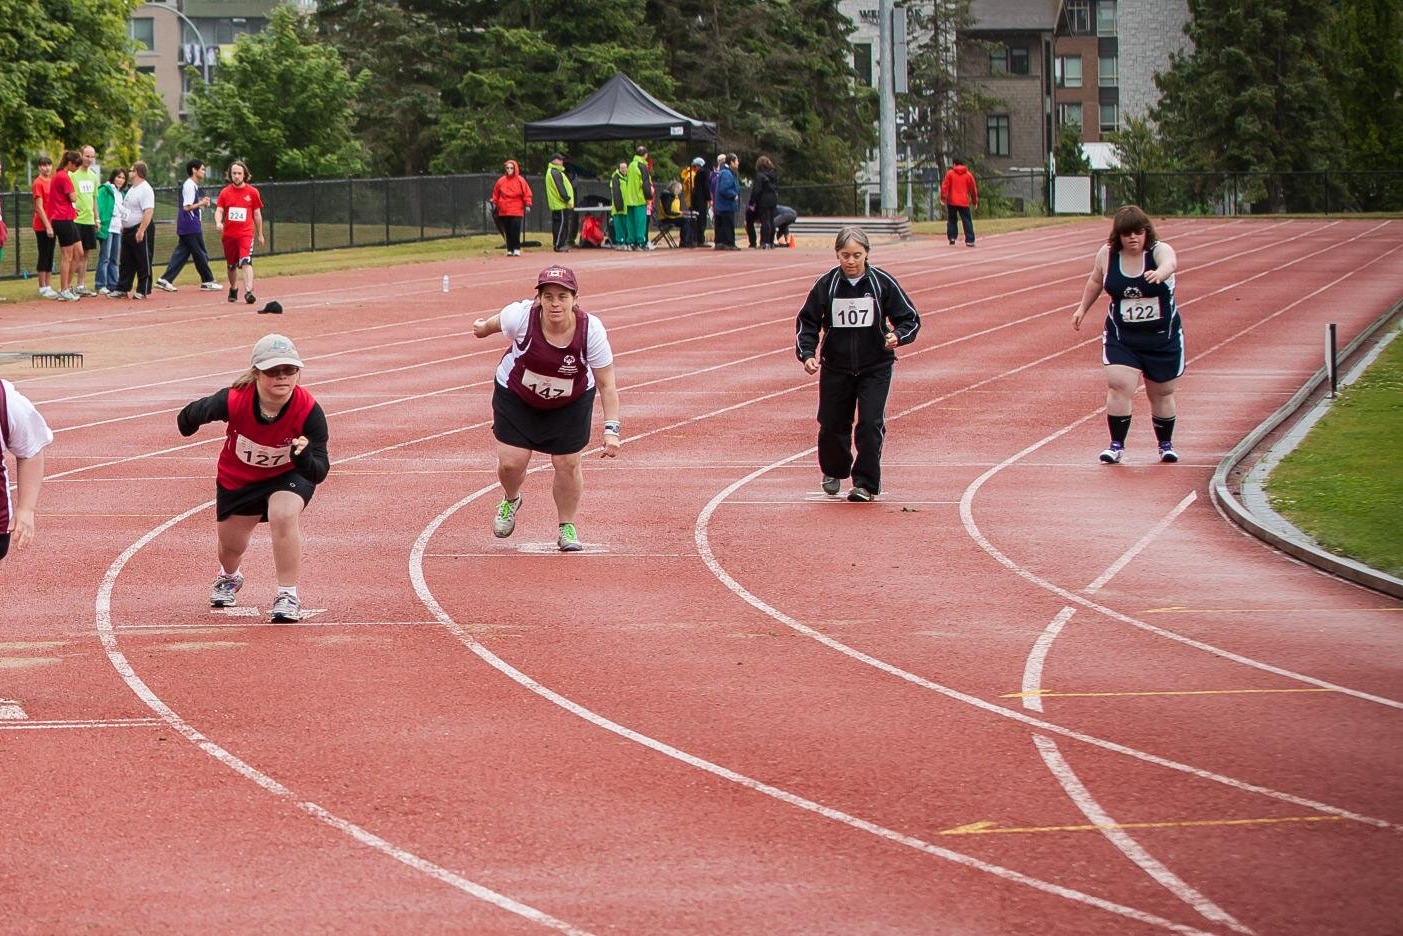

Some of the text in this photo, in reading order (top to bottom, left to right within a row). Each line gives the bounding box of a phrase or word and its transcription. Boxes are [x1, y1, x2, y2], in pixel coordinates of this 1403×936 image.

[838, 310, 868, 325] 107
[1126, 306, 1154, 320] 122
[529, 383, 564, 398] 147
[243, 451, 284, 466] 127
